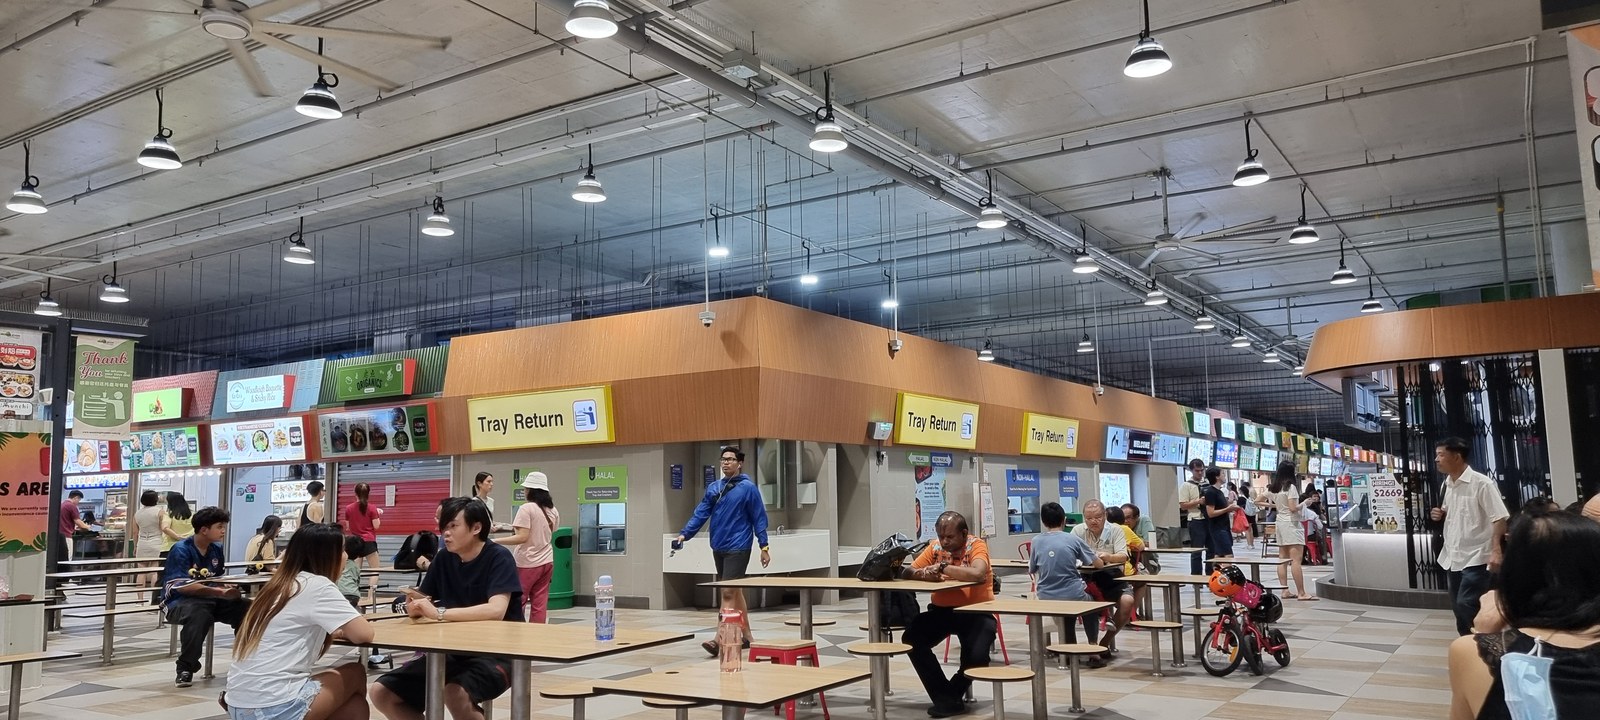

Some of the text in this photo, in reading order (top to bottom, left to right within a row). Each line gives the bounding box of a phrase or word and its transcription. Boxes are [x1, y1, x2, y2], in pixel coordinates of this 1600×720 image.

[82, 351, 128, 365] Thank
[78, 366, 103, 379] You
[357, 378, 382, 390] ORGANICS
[478, 412, 564, 435] Tray Return
[908, 412, 956, 432] Tray Return
[1032, 428, 1064, 444] Tray Return
[596, 471, 616, 479] HALAL
[16, 482, 49, 496] ARE
